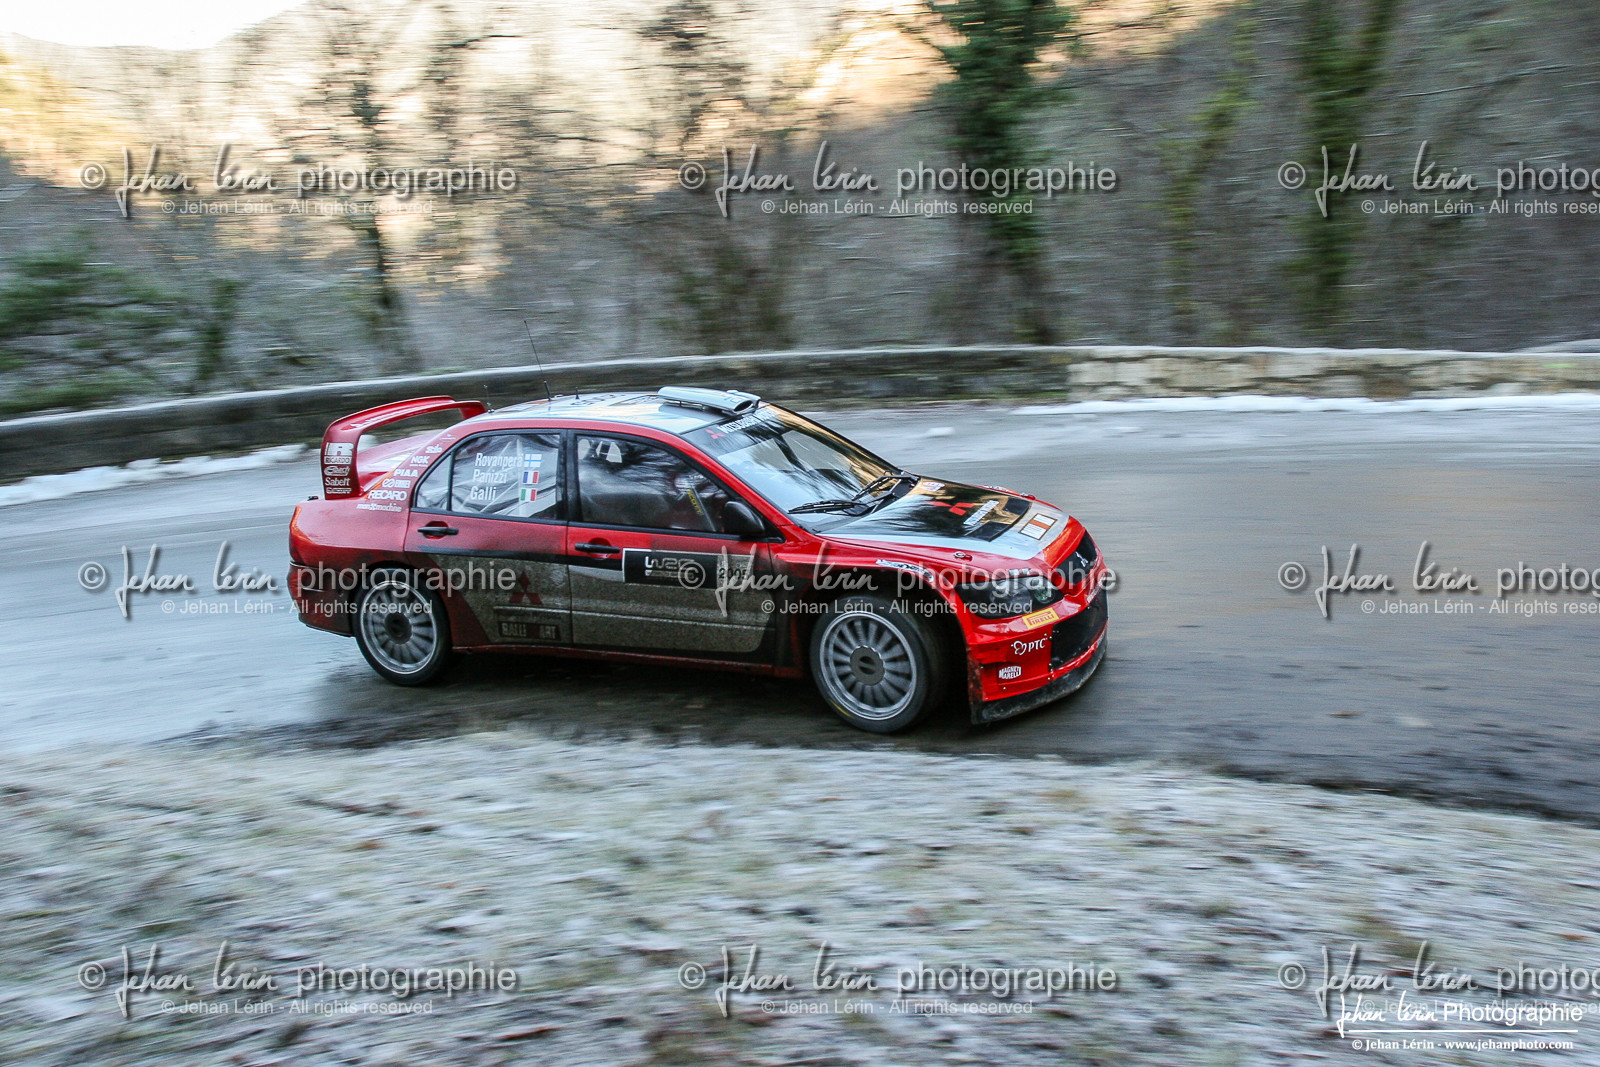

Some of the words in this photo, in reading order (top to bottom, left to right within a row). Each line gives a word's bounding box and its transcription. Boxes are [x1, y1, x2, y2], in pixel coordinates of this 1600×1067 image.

[410, 456, 430, 464] NGK
[393, 469, 418, 477] PIAA
[472, 468, 507, 483] Panizzi
[325, 477, 350, 486] Sabelt
[368, 490, 407, 501] RECARO
[470, 486, 497, 501] Galli
[1026, 611, 1055, 626] PIRELLI
